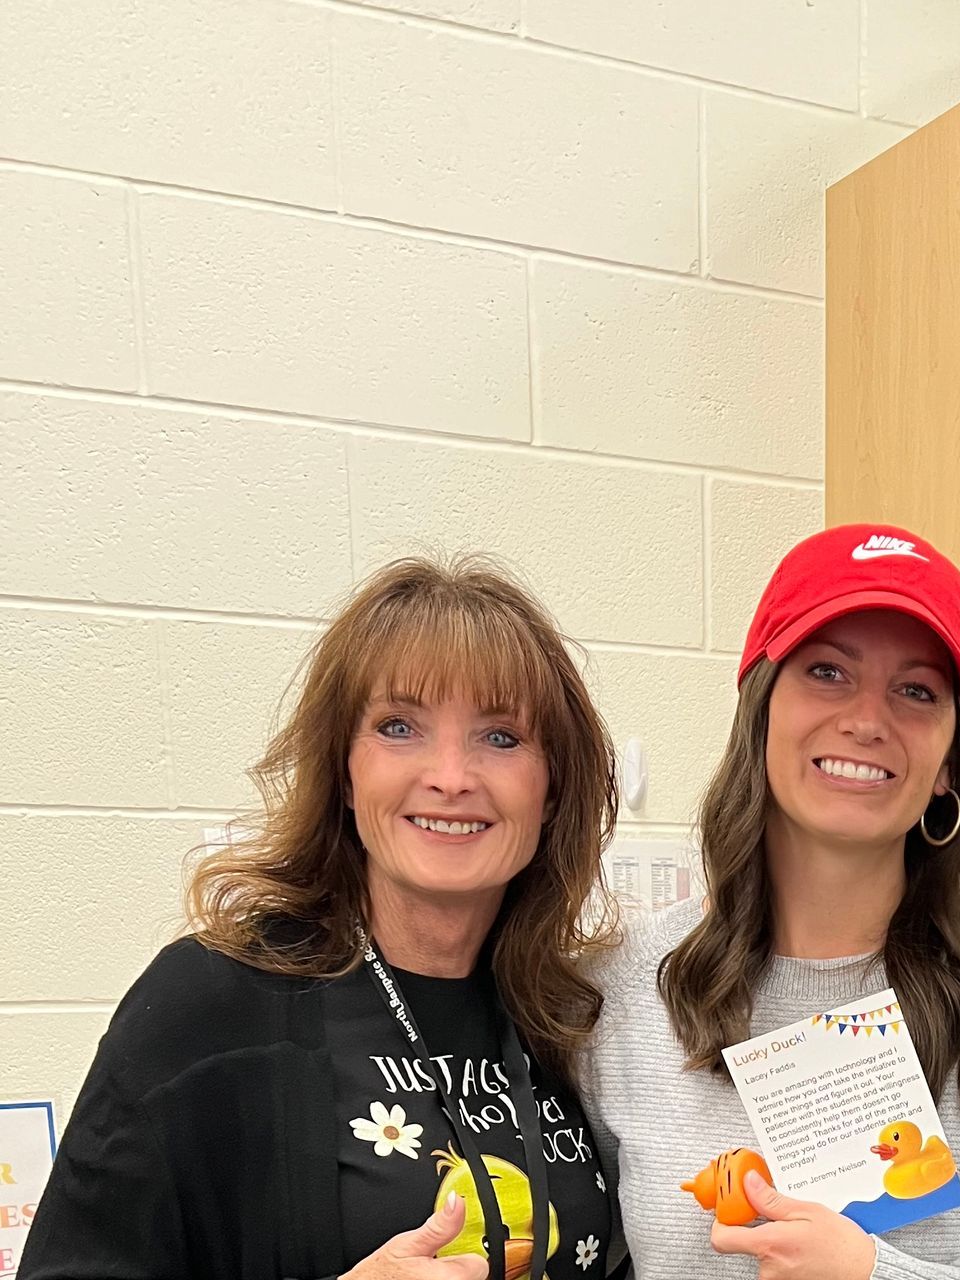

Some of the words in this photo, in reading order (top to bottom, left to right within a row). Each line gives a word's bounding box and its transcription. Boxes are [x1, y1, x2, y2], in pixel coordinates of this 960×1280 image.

[865, 534, 915, 551] NIKE
[395, 1002, 418, 1043] North
[732, 1047, 768, 1067] Lucky
[770, 1031, 807, 1053] Duck!
[369, 1055, 454, 1095] JUST
[462, 1058, 479, 1097] A
[744, 1072, 768, 1085] Lacey
[752, 1094, 769, 1104] You
[770, 1089, 784, 1098] are
[785, 1076, 818, 1093] amazing
[817, 1070, 835, 1080] with
[834, 1055, 876, 1075] technology
[878, 1048, 893, 1060] and
[893, 1046, 898, 1054] I
[757, 1100, 784, 1114] admire
[784, 1094, 801, 1104] how
[801, 1088, 817, 1099] you
[818, 1082, 833, 1092] can
[833, 1076, 851, 1086] take
[851, 1071, 865, 1080] the
[897, 1056, 906, 1064] to
[760, 1116, 771, 1124] try
[772, 1109, 789, 1120] new
[789, 1100, 814, 1113] things
[815, 1093, 830, 1105] and
[830, 1087, 853, 1099] figure
[853, 1083, 860, 1091] it
[875, 1071, 895, 1082] Your
[765, 1117, 797, 1134] patience
[798, 1110, 815, 1121] with
[815, 1106, 828, 1115] the
[829, 1094, 862, 1110] students
[863, 1087, 878, 1099] and
[768, 1135, 778, 1143] to
[778, 1119, 822, 1140] consistently
[823, 1113, 841, 1124] help
[840, 1106, 861, 1117] them
[890, 1092, 901, 1102] go
[776, 1149, 800, 1162] things
[800, 1144, 816, 1156] you
[816, 1140, 827, 1148] do
[827, 1136, 838, 1144] for
[839, 1130, 852, 1140] our
[853, 1119, 887, 1135] students
[907, 1105, 923, 1117] and
[812, 1124, 842, 1138] Thanks
[841, 1119, 853, 1128] for
[854, 1115, 864, 1125] all
[864, 1111, 873, 1121] of
[873, 1108, 887, 1117] the
[887, 1100, 909, 1112] many
[516, 1127, 593, 1164] UCK
[780, 1153, 817, 1172] everyday!
[787, 1180, 808, 1191] From
[810, 1170, 837, 1184] Jeremy
